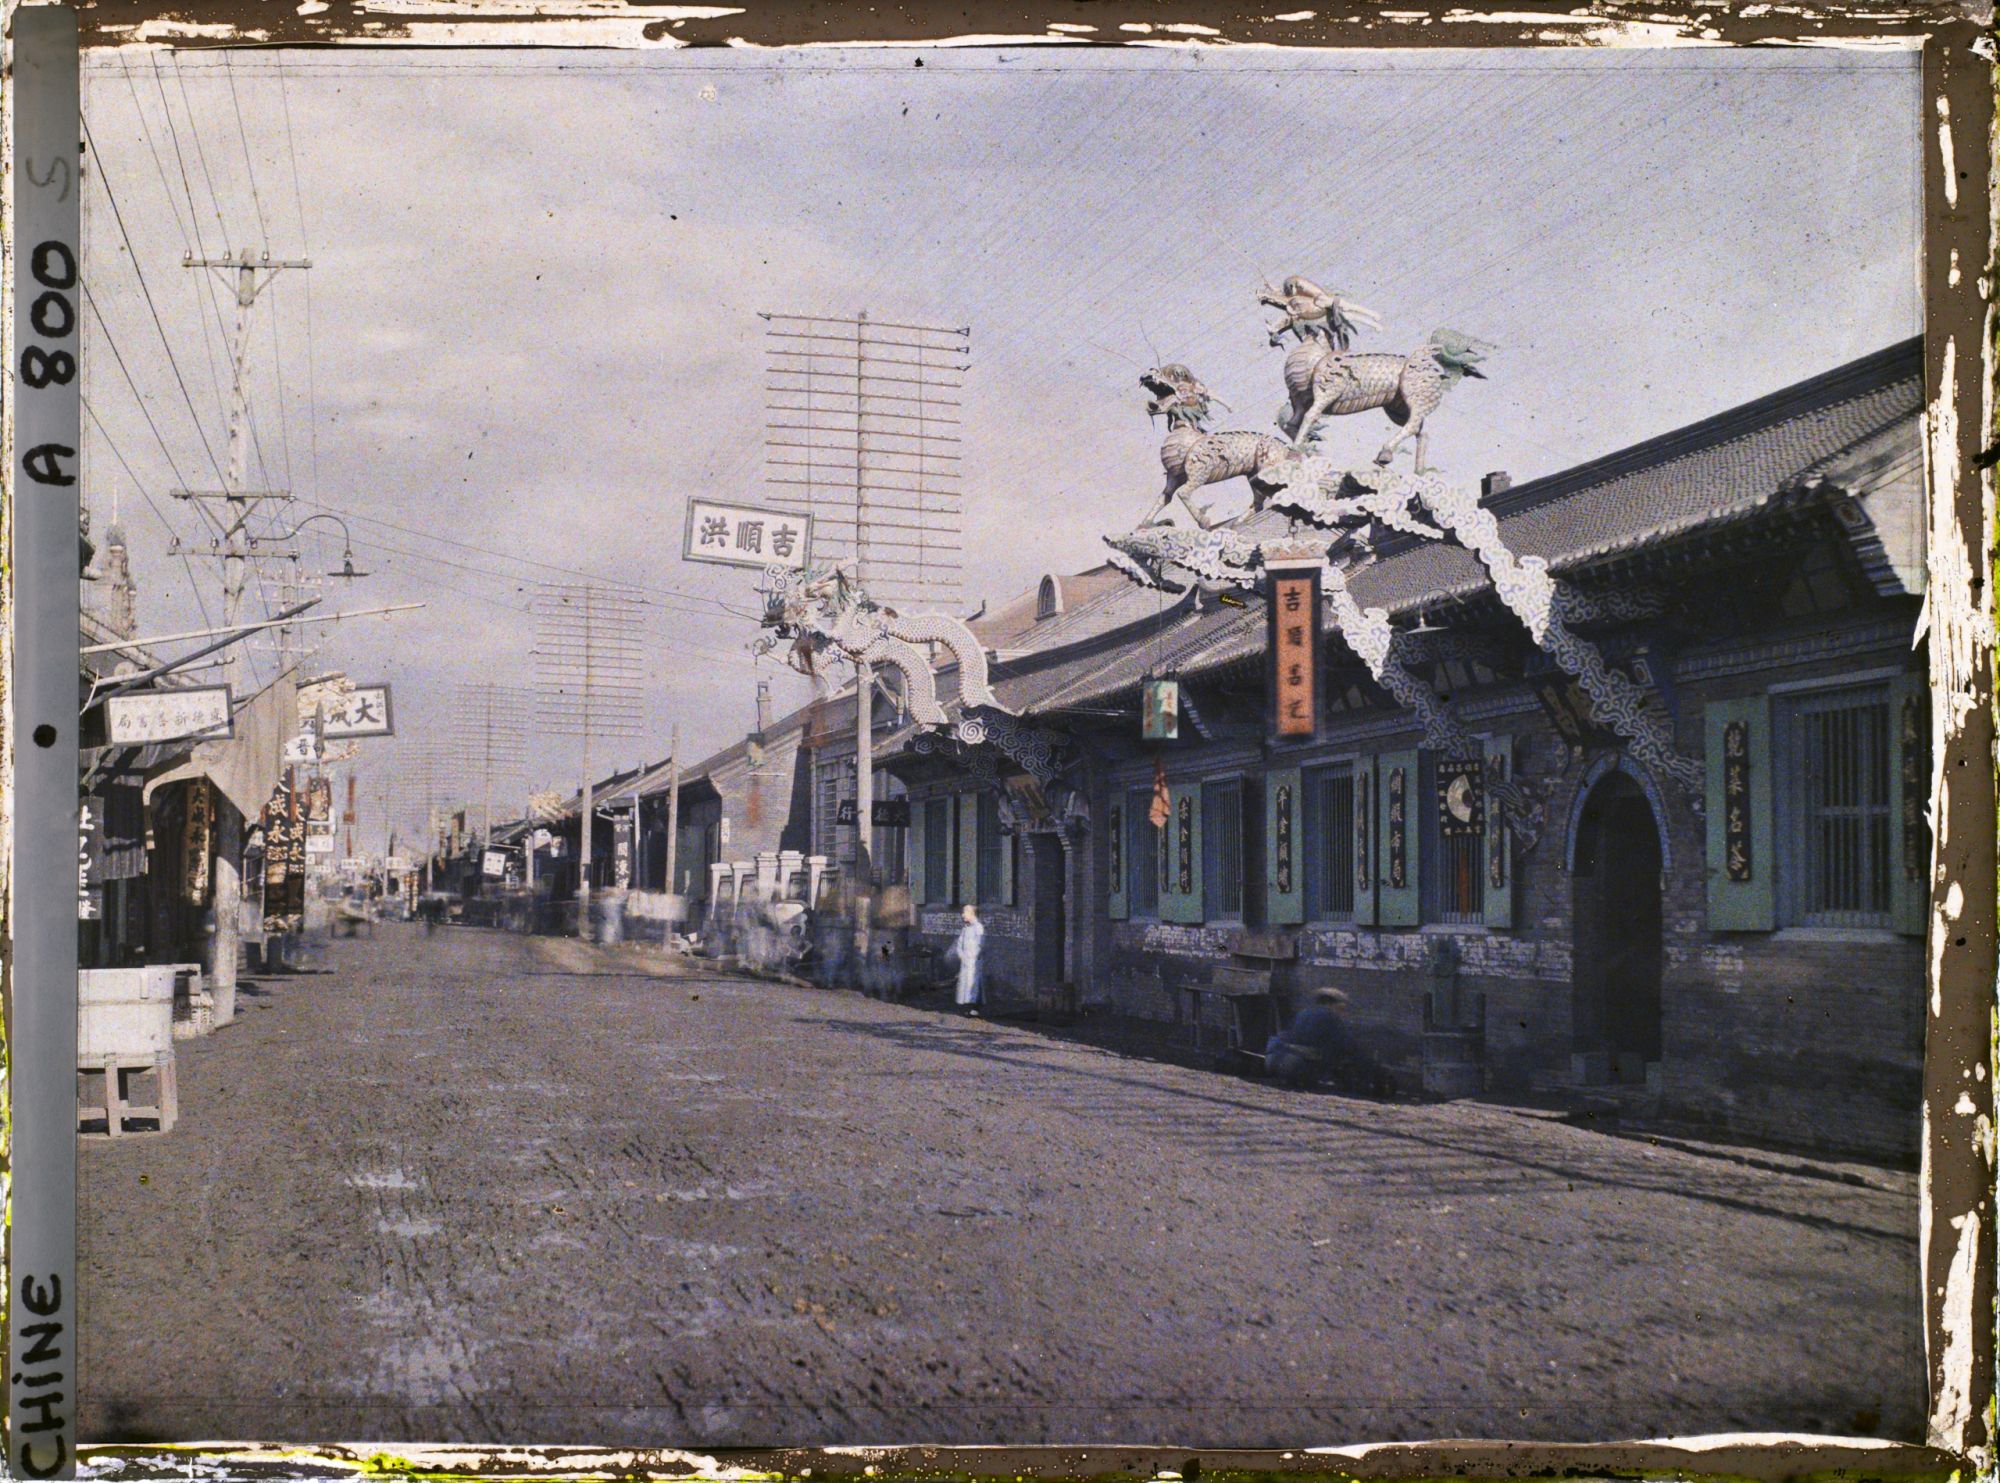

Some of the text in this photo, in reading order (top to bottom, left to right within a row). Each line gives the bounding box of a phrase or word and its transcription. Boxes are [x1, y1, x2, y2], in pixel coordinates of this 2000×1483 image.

[20, 240, 77, 389] 800
[22, 443, 76, 486] A
[700, 515, 798, 558] 吉順洪
